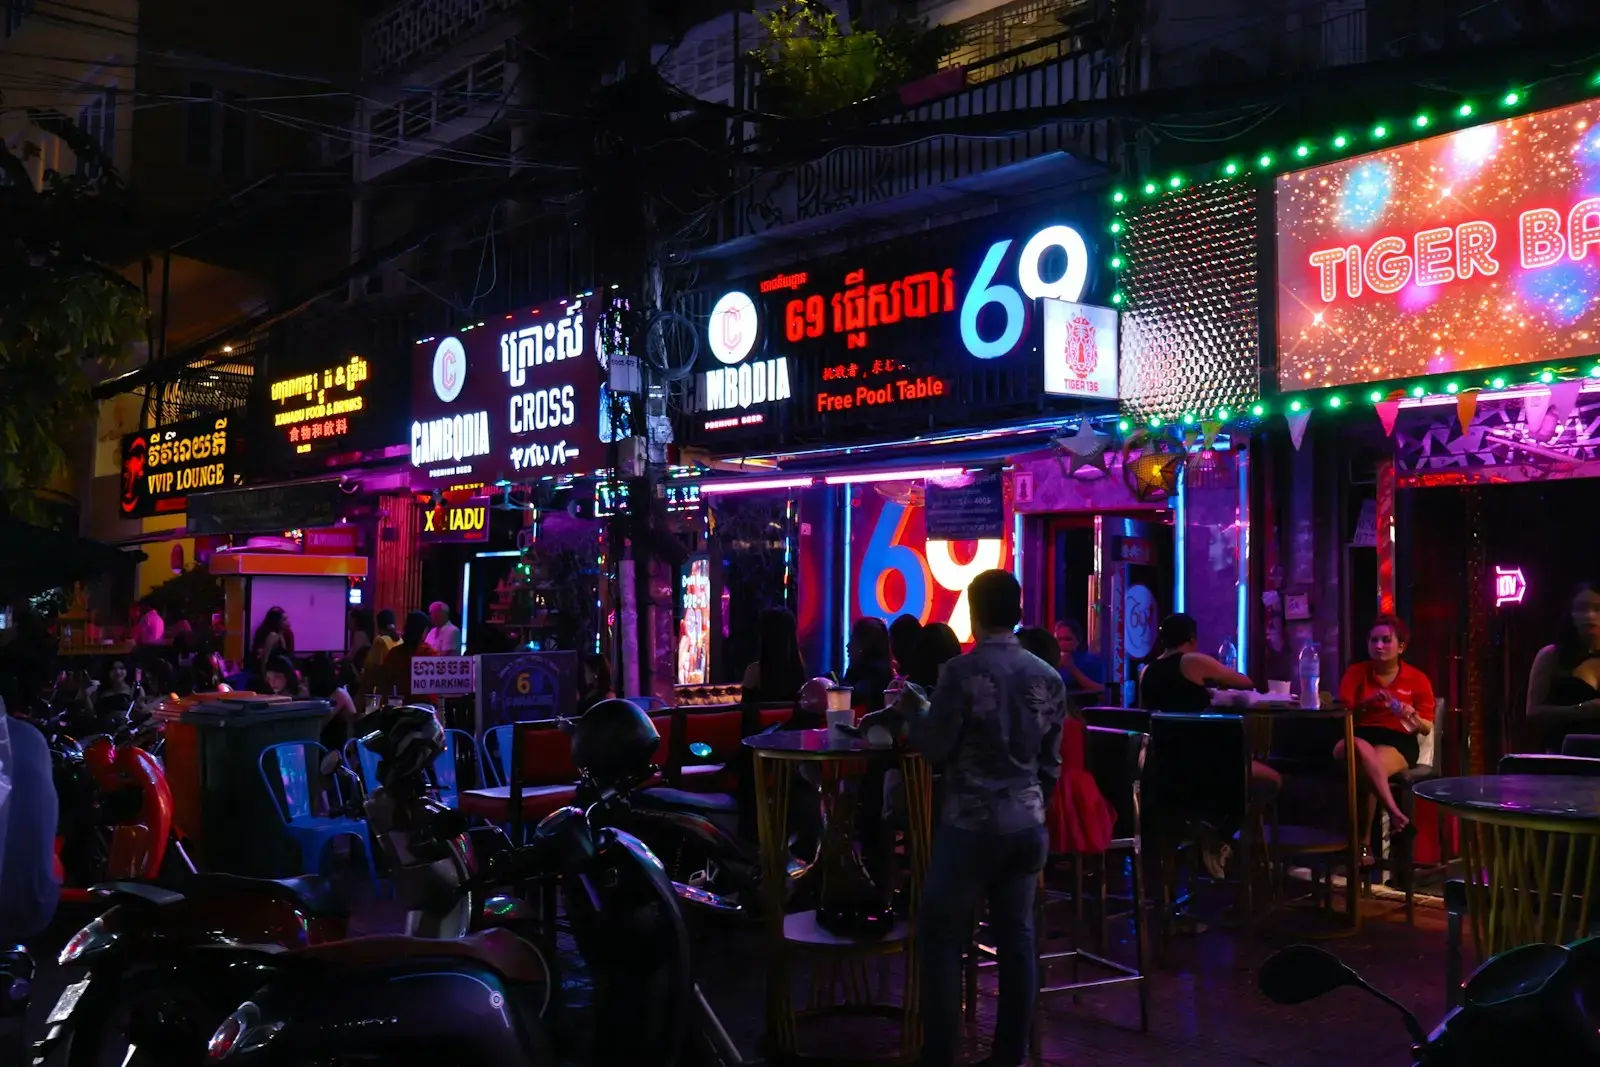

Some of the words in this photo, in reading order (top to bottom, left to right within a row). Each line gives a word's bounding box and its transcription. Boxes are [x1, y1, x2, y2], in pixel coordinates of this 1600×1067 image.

[1309, 220, 1499, 302] TIGER
[960, 225, 1088, 359] 69
[785, 294, 825, 343] 69
[817, 391, 852, 413] Free
[856, 384, 893, 408] Pool
[896, 375, 944, 403] Table
[1064, 378, 1086, 391] TIGER
[306, 405, 325, 420] FOOD
[333, 396, 363, 415] DRINKS
[510, 385, 574, 434] CROSS
[289, 418, 347, 442] 食物和飲料
[411, 411, 490, 467] CAMBODIA
[148, 472, 174, 494] VVIP
[176, 463, 224, 490] LOUNGE
[414, 661, 469, 675] ហាមចត
[414, 679, 426, 689] NO
[430, 678, 470, 689] PARKING
